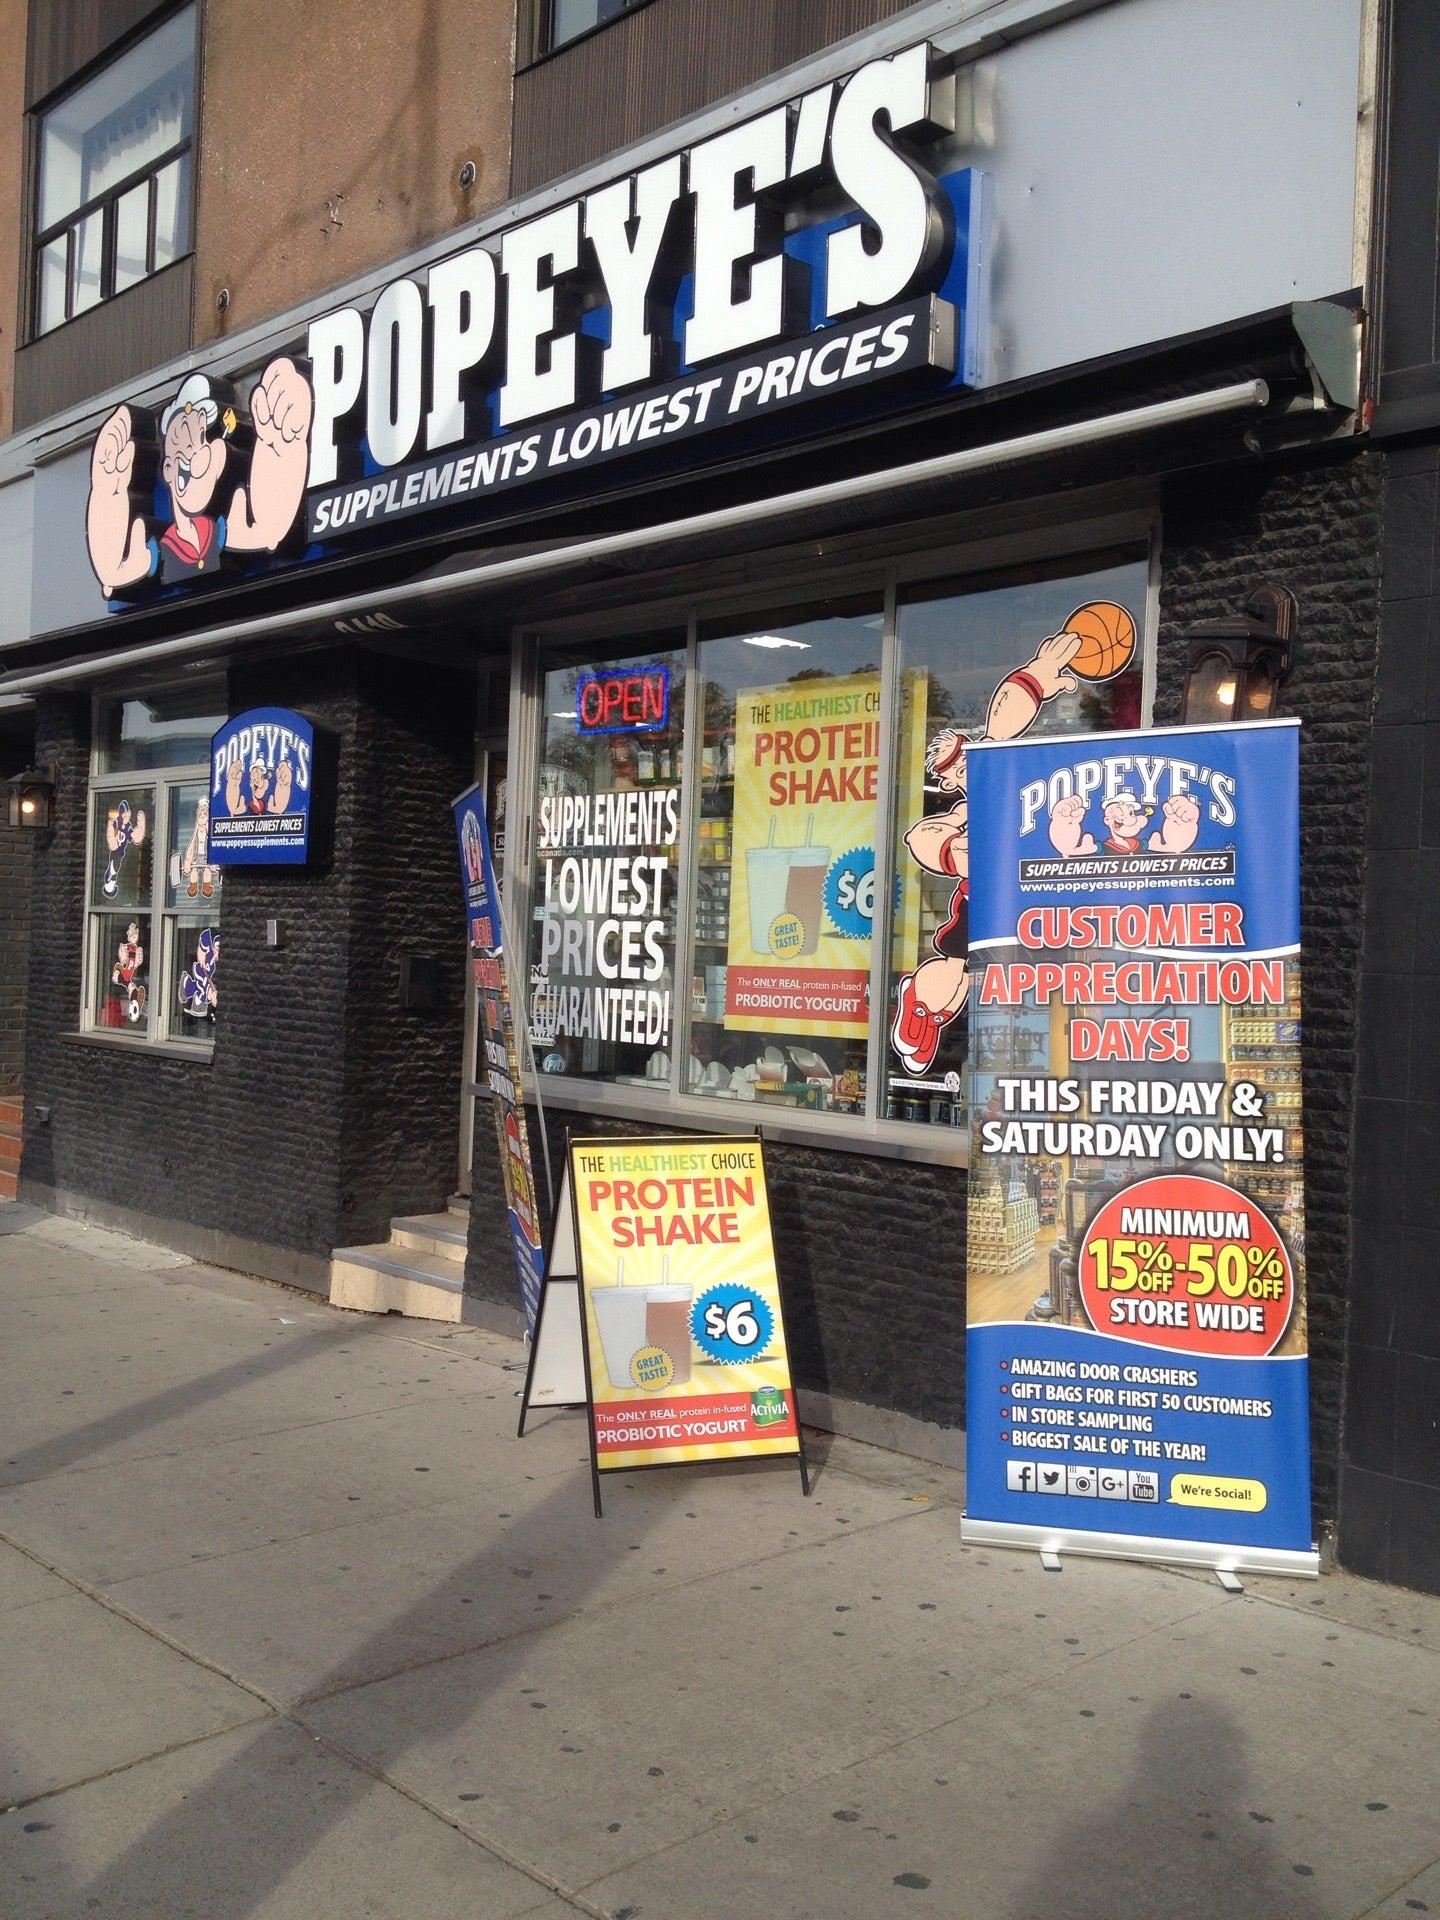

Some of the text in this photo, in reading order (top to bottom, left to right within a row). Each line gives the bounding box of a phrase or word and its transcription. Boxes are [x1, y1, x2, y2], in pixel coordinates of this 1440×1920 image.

[307, 41, 930, 488] POPEYE'S
[312, 315, 915, 534] SUPPLEMENTS LOWEST PRICES
[581, 675, 665, 725] OPEN
[751, 704, 771, 724] THE
[774, 694, 862, 723] HEALTHIEST
[213, 723, 310, 797] POPEYE'S
[769, 765, 878, 807] SHAKE
[1019, 755, 1237, 838] POPEYE'S
[214, 818, 302, 834] SUPPLEMENTS LOWEST PRICES
[540, 789, 678, 848] SUPPLEMENTS
[211, 837, 305, 849] www.popeyessupplements.com
[1026, 856, 1228, 877] SUPPLEMENTS LOWEST PRICES
[544, 856, 668, 916] LOWEST
[837, 868, 875, 918] $6
[1020, 877, 1235, 893] www.popeyessupplements.com
[775, 922, 798, 937] GREAT
[775, 935, 799, 950] TASTE!
[1016, 903, 1245, 949] CUSTOMER
[541, 919, 665, 982] PRICES
[737, 977, 751, 987] The
[753, 978, 777, 988] ONLY
[779, 978, 801, 989] REAL
[803, 980, 830, 992] protein
[831, 981, 862, 992] in-fused
[979, 960, 1285, 1005] APPRECIATION
[533, 983, 669, 1047] GUARANTEED!
[735, 994, 861, 1013] PROBIOTIC YOGURT
[1070, 1018, 1191, 1062] DAYS!
[998, 1079, 1263, 1118] THIS FRIDAY &
[981, 1121, 1284, 1163] SATURDAY ONLY!
[580, 1152, 756, 1173] THE HEALTHIEST CHOICE
[588, 1176, 755, 1211] PROTEIN
[611, 1213, 740, 1248] SHAKE
[1120, 1207, 1251, 1240] MINIMUM
[1137, 1271, 1174, 1292] OFF
[1247, 1277, 1284, 1300] OFF
[704, 1300, 760, 1347] $6
[1110, 1297, 1265, 1333] STORE WIDE
[636, 1354, 664, 1370] GREAT
[638, 1366, 669, 1382] TASTE!
[1011, 1359, 1198, 1388] AMAZING DOOR CRASHERS
[596, 1400, 789, 1423] The ONLY REAL protein in-fused ACTIVIA
[1011, 1382, 1272, 1418] GIFT BAGS FOR FIRST 50 CUSTOMERS
[597, 1418, 748, 1444] PROBIOTIC YOGURT
[1012, 1406, 1153, 1433] IN STORE SAMPLING
[1012, 1430, 1207, 1462] BIGGEST SALE OF THE YEAR!
[1133, 1485, 1154, 1499] Tube
[1136, 1473, 1150, 1483] You
[1180, 1483, 1252, 1500] We're Social!
